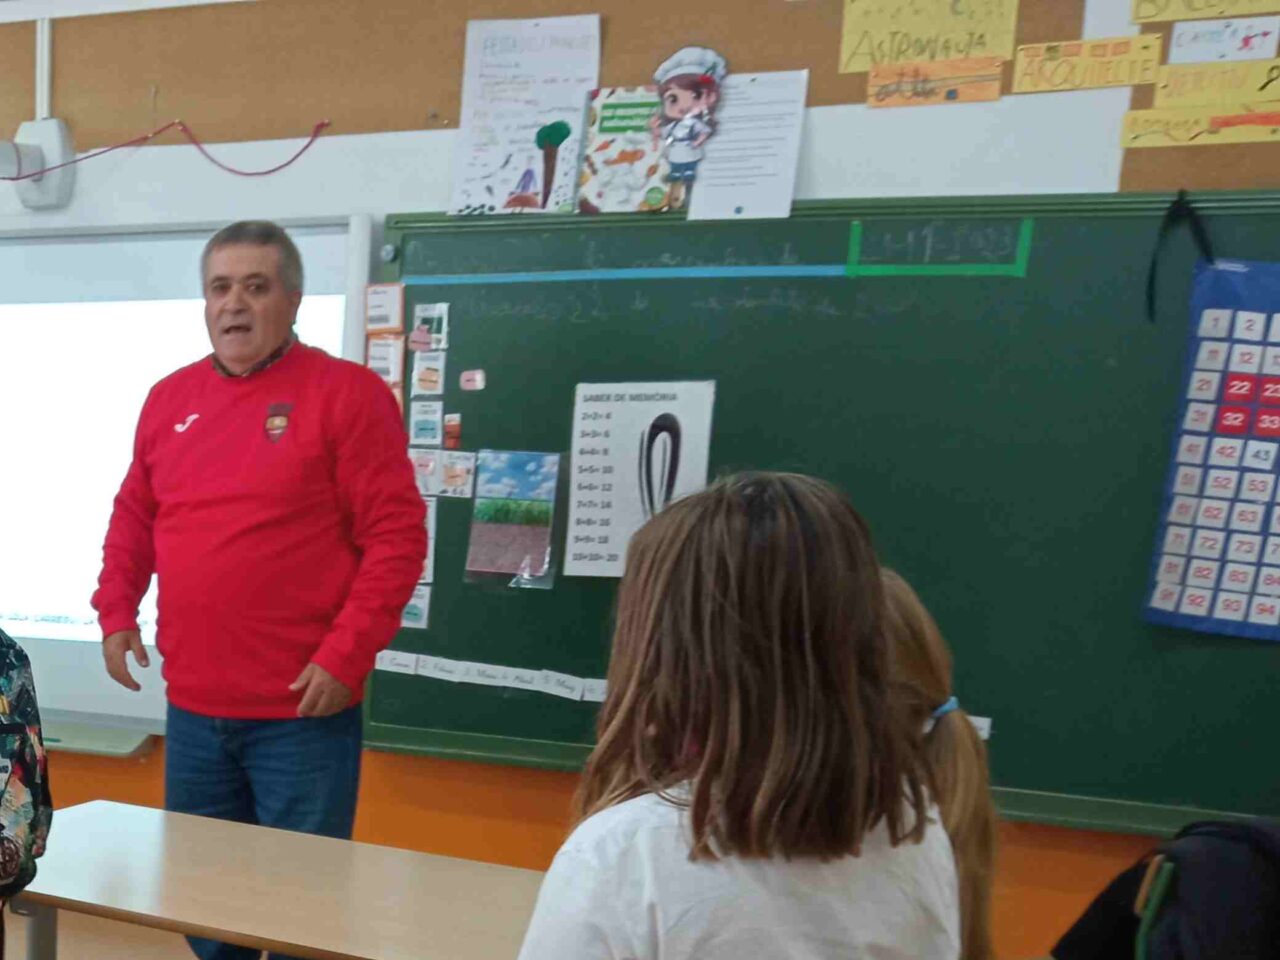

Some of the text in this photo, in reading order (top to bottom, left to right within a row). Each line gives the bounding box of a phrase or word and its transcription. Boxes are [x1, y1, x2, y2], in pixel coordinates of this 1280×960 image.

[1245, 319, 1256, 331] 2
[1239, 351, 1255, 364] 12
[1195, 379, 1212, 391] 21
[1229, 381, 1251, 394] 22
[614, 394, 625, 402] DE
[1222, 412, 1244, 425] 32
[1258, 415, 1280, 429] 33
[1216, 445, 1237, 458] 42
[1252, 450, 1270, 462] 43
[1212, 476, 1232, 489] 52
[1248, 479, 1267, 492] 53
[1202, 506, 1222, 519] 62
[1237, 510, 1258, 523] 63
[1200, 536, 1218, 549] 72
[1235, 540, 1255, 553] 73
[1271, 543, 1280, 555] 7
[1193, 566, 1212, 579] 82
[1228, 570, 1249, 583] 83
[1187, 593, 1205, 607] 92
[1222, 599, 1242, 612] 93
[1256, 602, 1275, 616] 94
